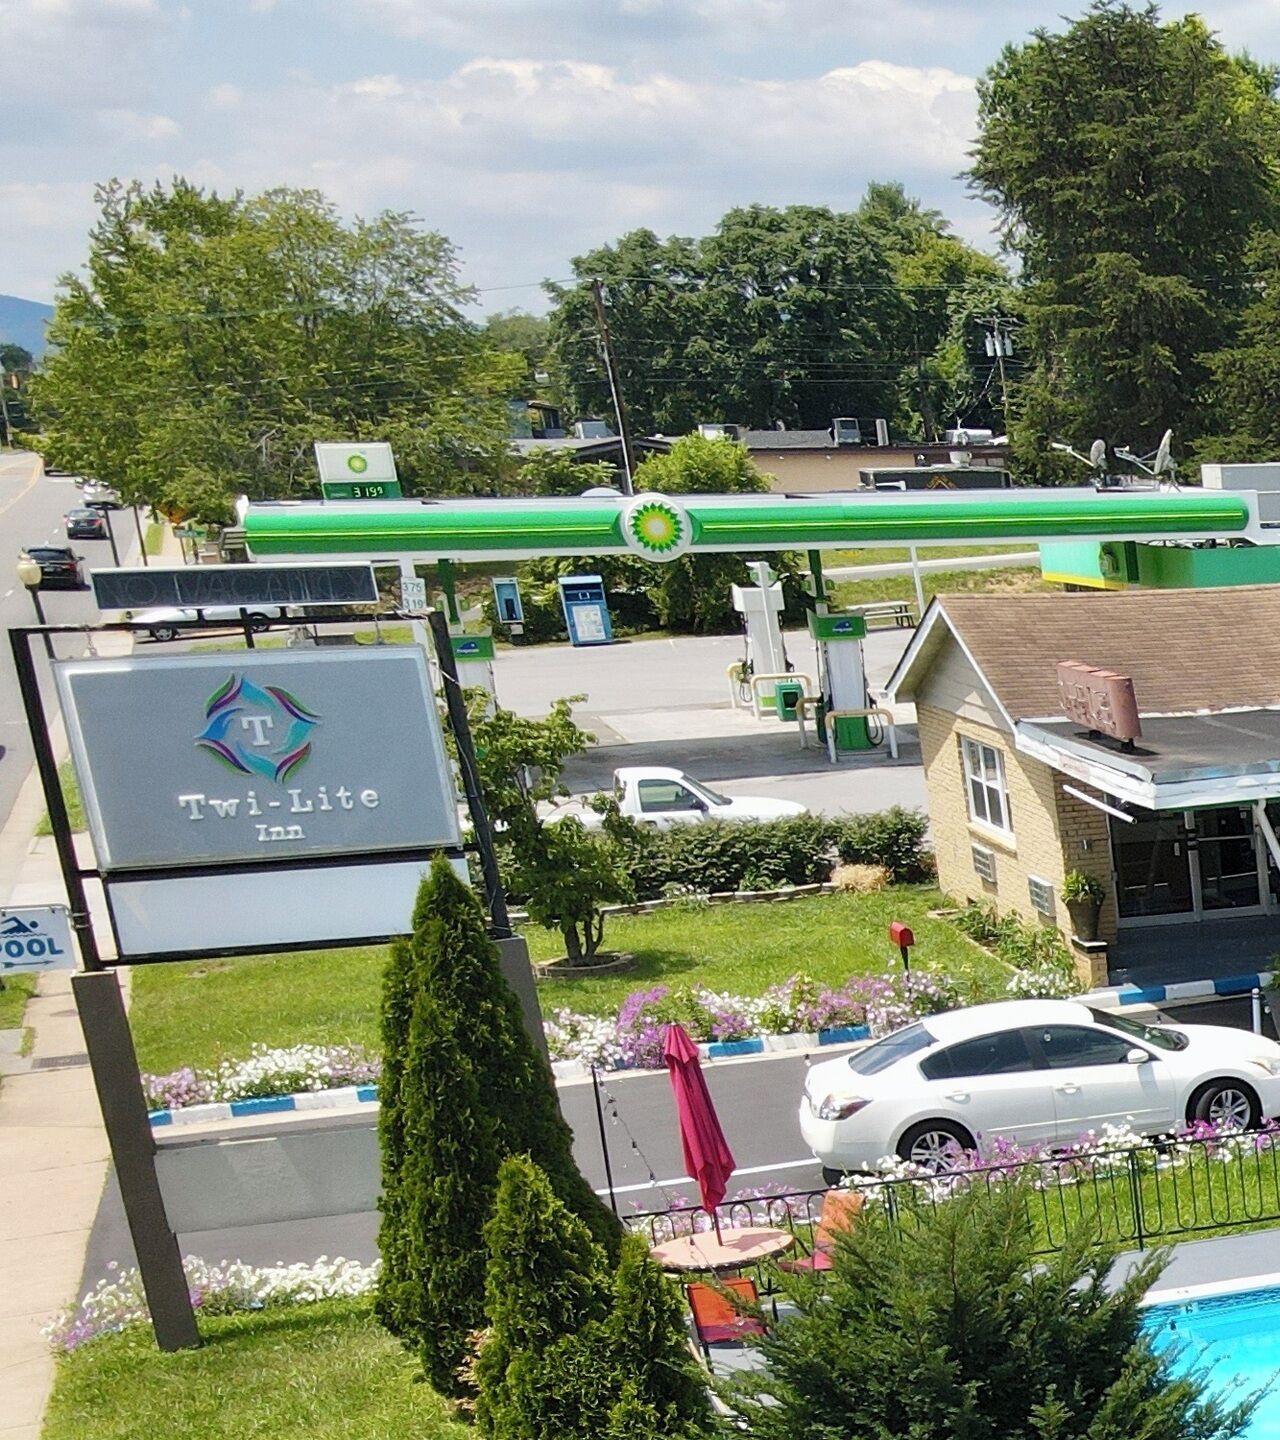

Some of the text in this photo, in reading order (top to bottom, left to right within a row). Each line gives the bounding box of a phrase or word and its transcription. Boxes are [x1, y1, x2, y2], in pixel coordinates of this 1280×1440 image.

[241, 715, 274, 747] T
[178, 785, 380, 821] Twi-Lite
[255, 823, 306, 842] Inn
[0, 937, 65, 958] OOL
